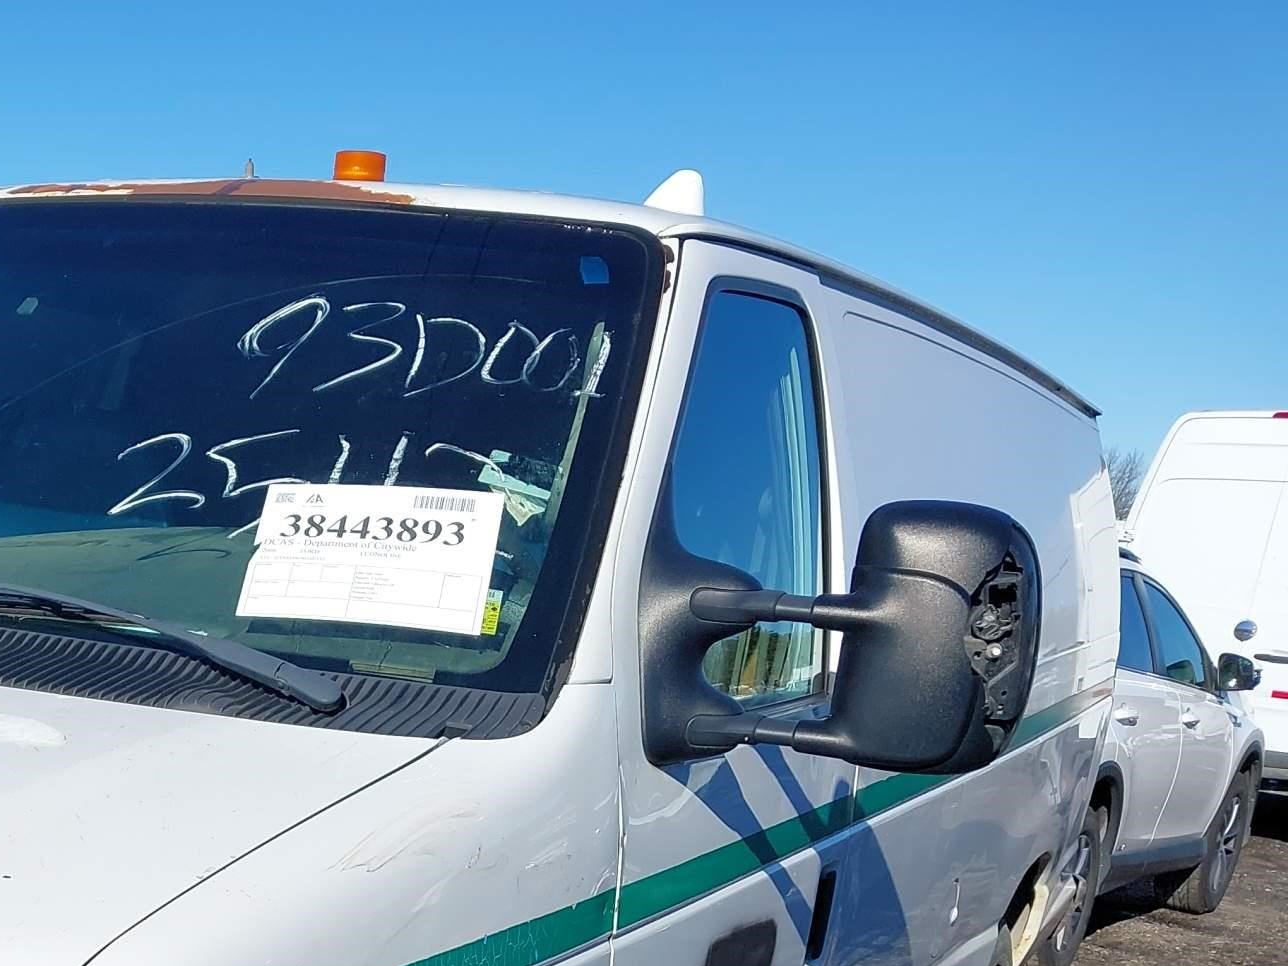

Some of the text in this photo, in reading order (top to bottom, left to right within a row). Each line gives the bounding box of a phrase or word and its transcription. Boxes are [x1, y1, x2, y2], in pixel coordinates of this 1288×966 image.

[279, 513, 465, 547] 38443893
[303, 539, 362, 550] Department
[361, 540, 373, 549] of
[372, 541, 418, 553] Citywide
